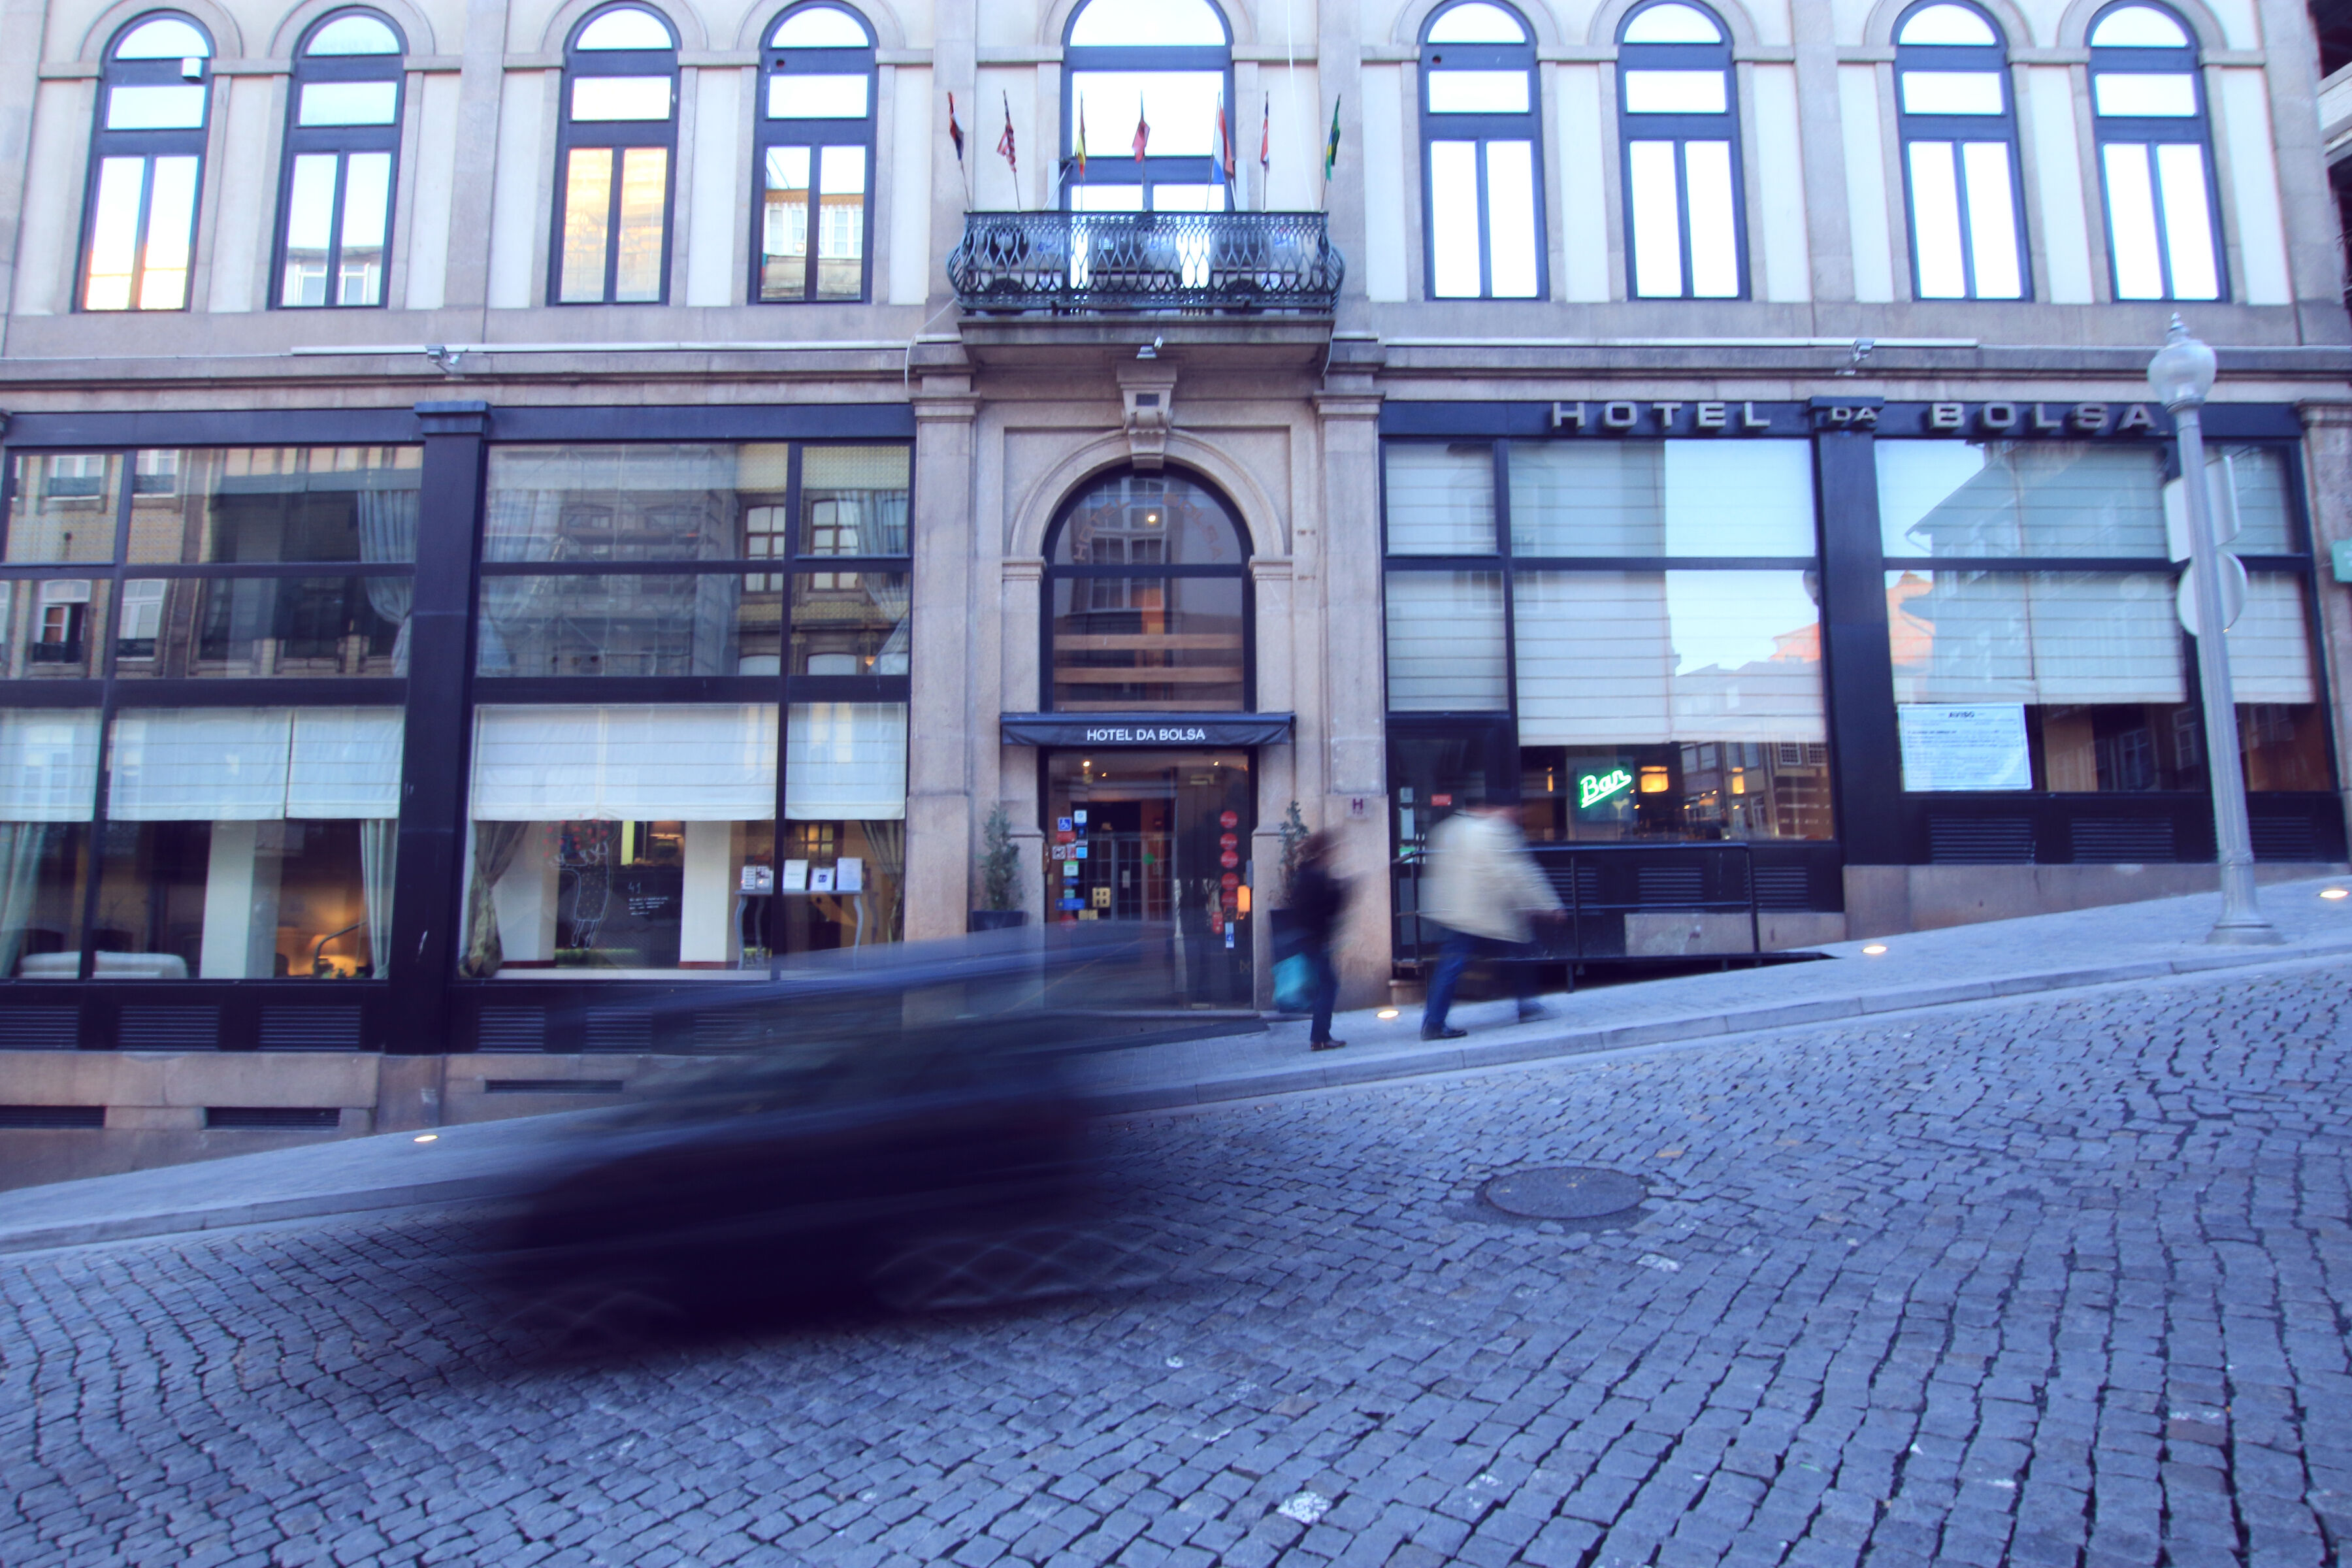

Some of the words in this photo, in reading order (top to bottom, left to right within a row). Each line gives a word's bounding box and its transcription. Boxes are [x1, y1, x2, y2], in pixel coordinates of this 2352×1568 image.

[1552, 402, 1771, 427] HOTEL
[1831, 407, 1878, 421] DA
[1929, 402, 2156, 429] BOLSA
[1086, 728, 1133, 741] HOTEL
[1136, 728, 1156, 741] DA
[1159, 728, 1206, 741] BOLSA
[1580, 770, 1632, 808] Bar
